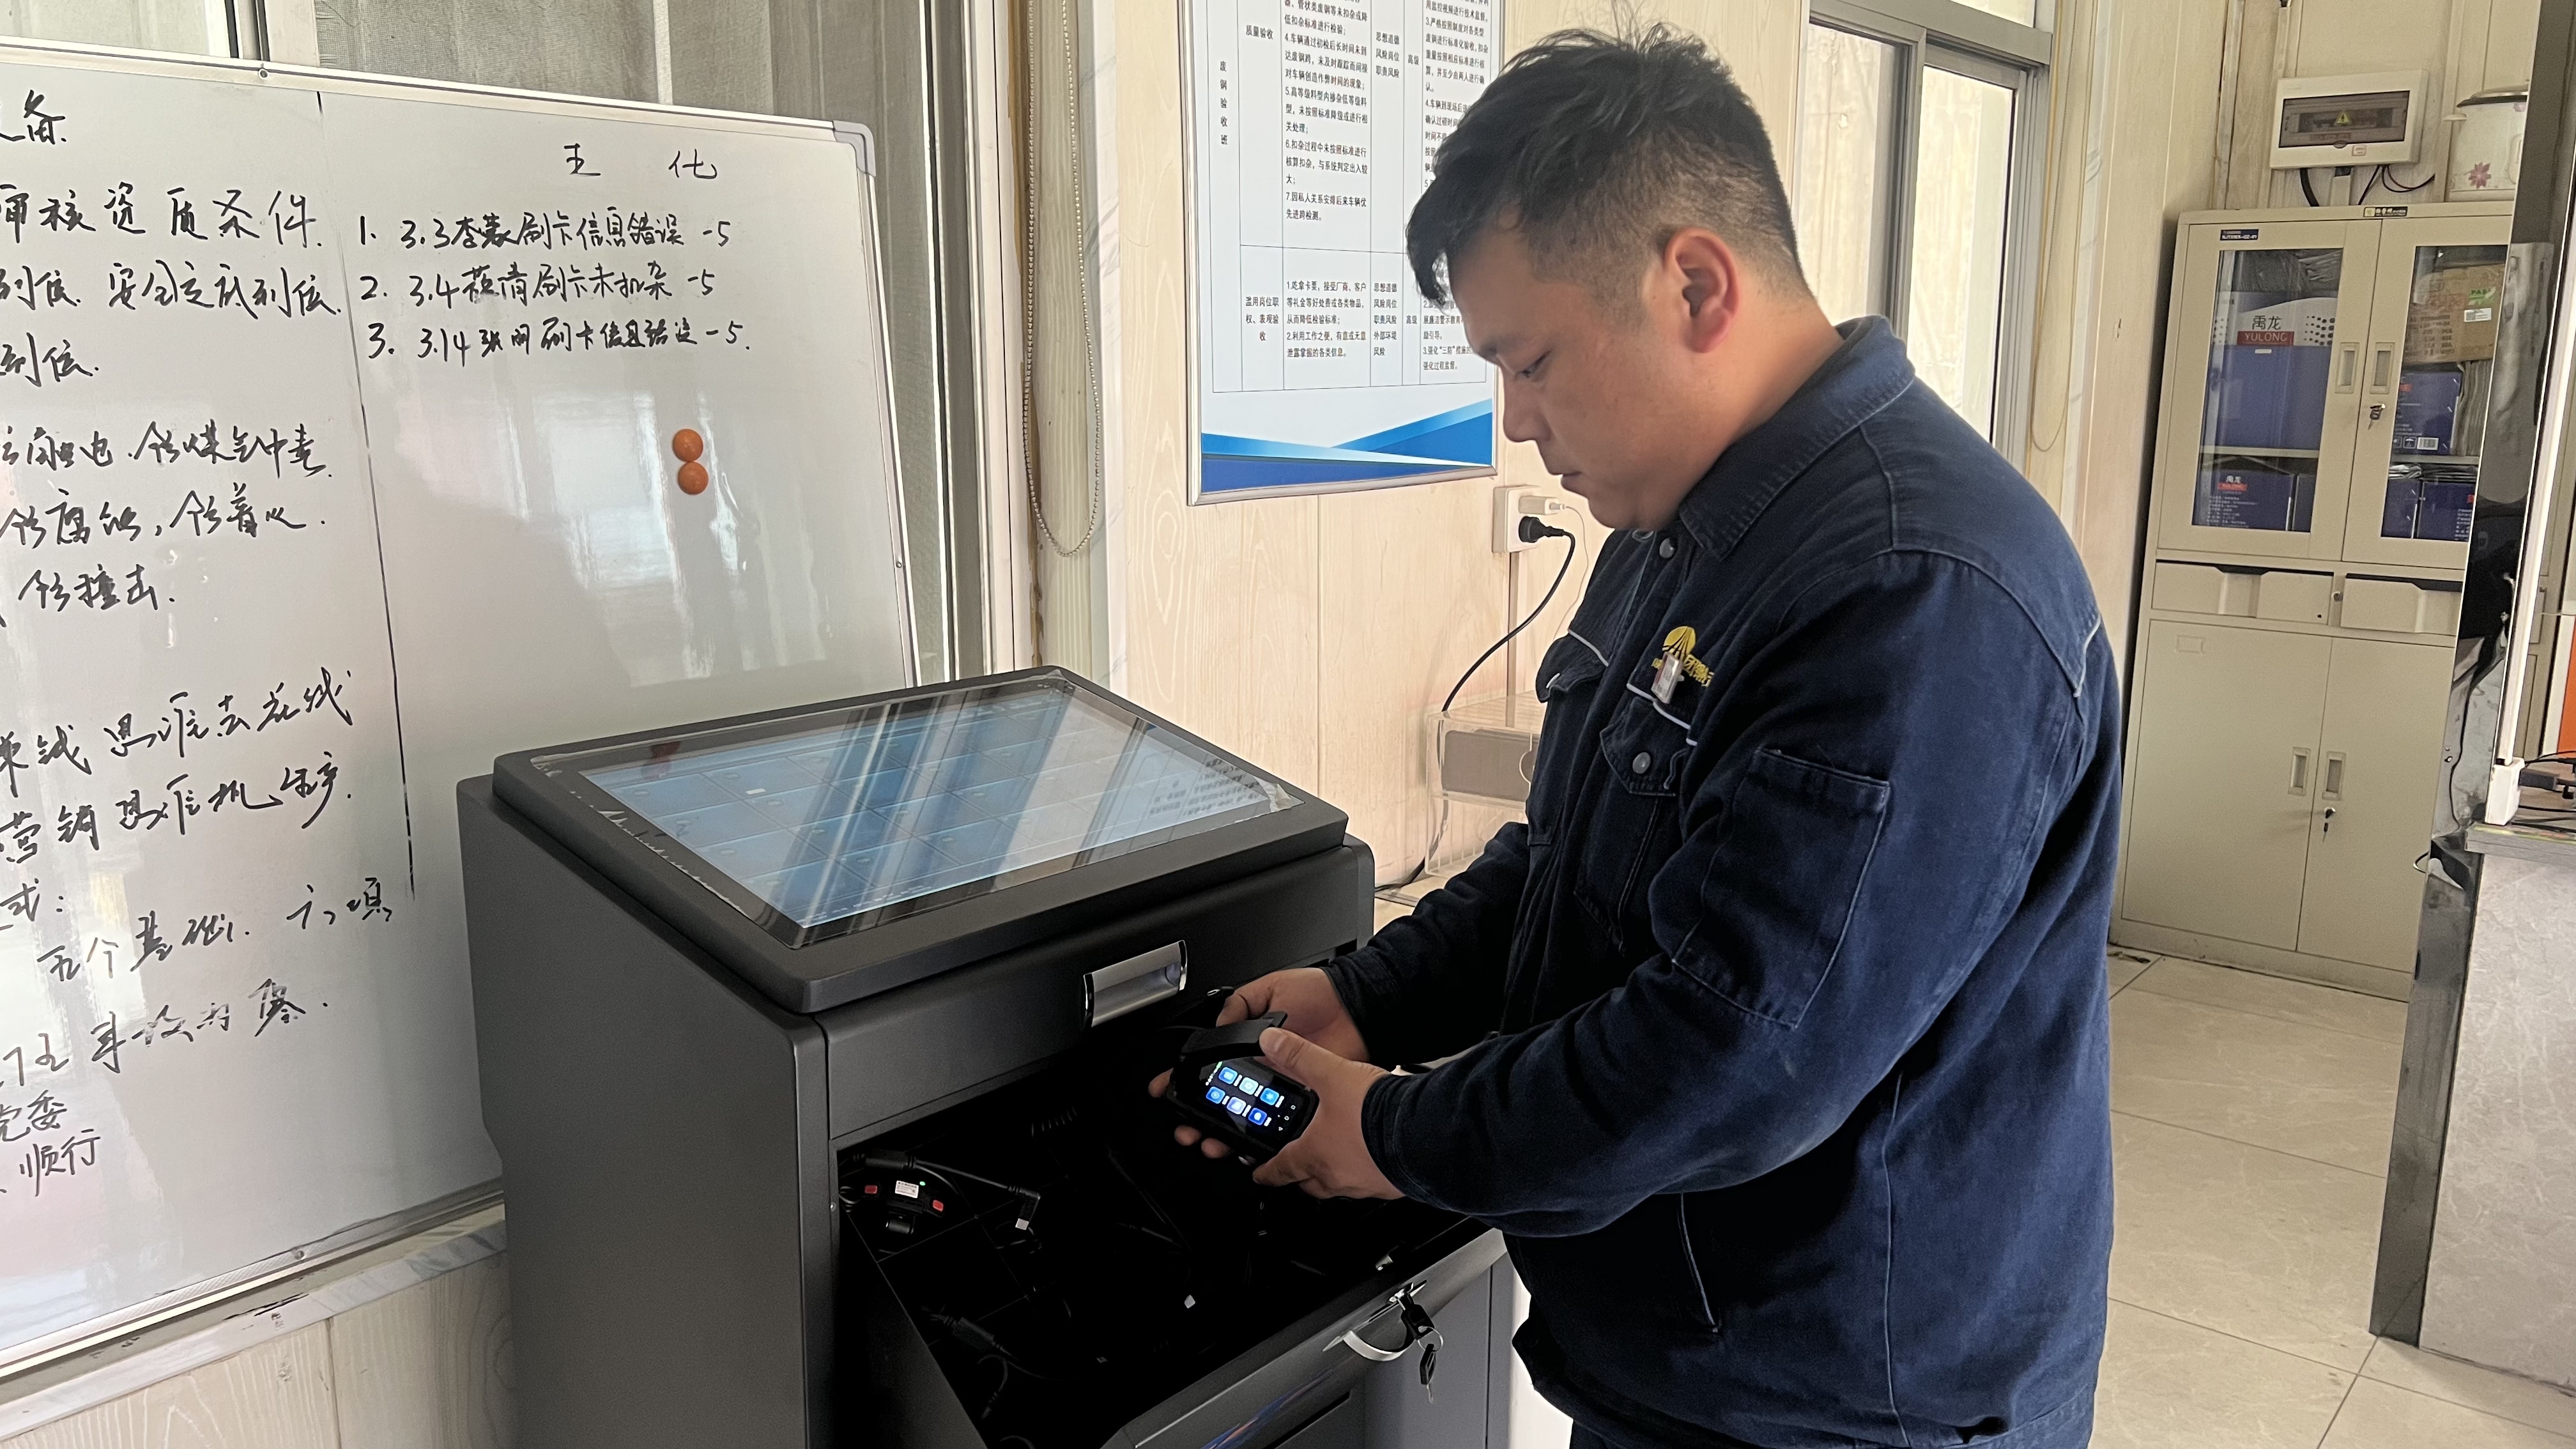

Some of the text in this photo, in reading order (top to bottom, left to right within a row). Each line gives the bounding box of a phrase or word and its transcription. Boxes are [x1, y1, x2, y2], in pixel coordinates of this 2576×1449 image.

[1284, 14, 1346, 36] 低扣杂标准进行检验；
[1425, 17, 1484, 37] 3.严格按照制度对各类型
[1246, 24, 1273, 40] 质量验收
[1376, 31, 1400, 45] 思想道德
[1285, 33, 1367, 56] 4.车辆通过初检后长时间未到
[1376, 48, 1400, 61] 风险岗位
[1408, 54, 1420, 65] 高级
[1425, 49, 1485, 69] 重量按照相应标准进行核
[1376, 65, 1400, 78] 职责风险
[1425, 65, 1485, 84] 算，并至少由两人进行确
[1285, 68, 1365, 90] 对车辆创造作弊时间的现象；
[1425, 82, 1434, 93] 认。
[1285, 86, 1367, 107] 5.高等级料型内掺杂低等级料
[1285, 103, 1368, 124] 型，未按照标准降级或进行相
[1285, 121, 1308, 134] 关处理；
[1285, 139, 1367, 157] 6.扣杂过程中未按照标准进行
[1285, 156, 1368, 174] 核算扣杂，与系统判定出入较
[1286, 174, 1296, 185] 大；
[1285, 192, 1367, 208] 7.因私人关系安排后来车辆优
[1286, 208, 1322, 221] 先进跨检测。
[1374, 283, 1397, 293] 思想道德
[1246, 296, 1279, 307] 滥用岗位职
[1374, 299, 1397, 309] 风险岗位
[1246, 314, 1279, 325] 权、表观验
[1287, 314, 1340, 325] 从而降低检验标准；
[1374, 315, 1397, 325] 职责风险
[1406, 315, 1418, 325] 高级
[1423, 315, 1464, 325] 展廉洁警示教育
[2252, 315, 2282, 330] 禹龙
[1259, 331, 1266, 341] 收
[1374, 331, 1397, 341] 外部环境
[2244, 332, 2288, 342] YULONG
[1287, 348, 1347, 358] 泄露掌握的各类信息。
[1374, 347, 1386, 356] 风险
[1423, 361, 1458, 371] 强化过程监督。
